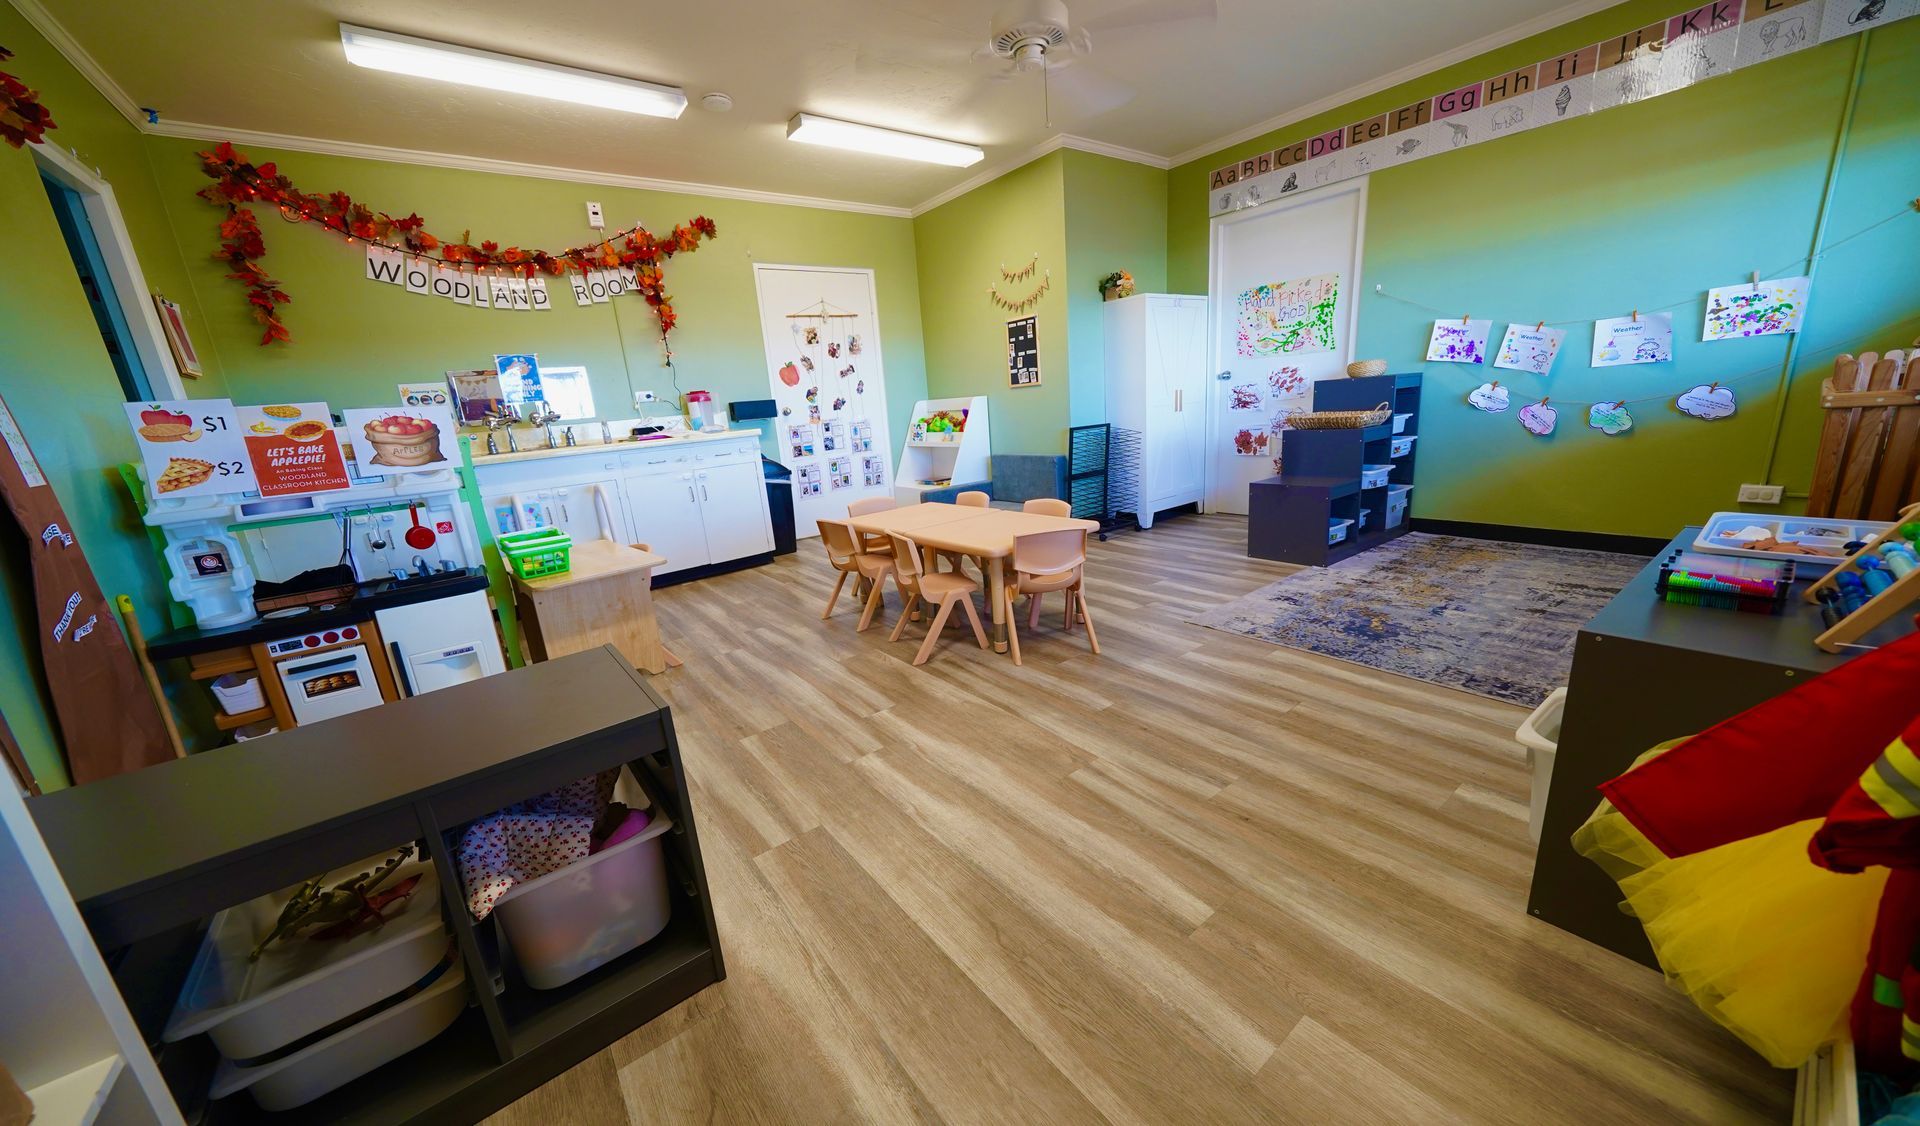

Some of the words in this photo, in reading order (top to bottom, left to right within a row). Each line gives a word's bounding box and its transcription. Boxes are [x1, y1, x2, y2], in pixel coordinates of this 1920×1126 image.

[369, 257, 548, 305] WOODLAND
[574, 275, 639, 301] ROOM
[1614, 325, 1643, 334] Weather
[1520, 334, 1544, 342] Weather
[202, 415, 227, 433] $1
[266, 446, 295, 457] LET'S
[297, 444, 324, 455] BAKE
[271, 453, 327, 467] APPLEPIE!
[217, 461, 245, 477] $2
[279, 472, 327, 481] WOODLAND
[262, 481, 313, 491] CLASSROOM
[314, 477, 347, 486] KITCHEN
